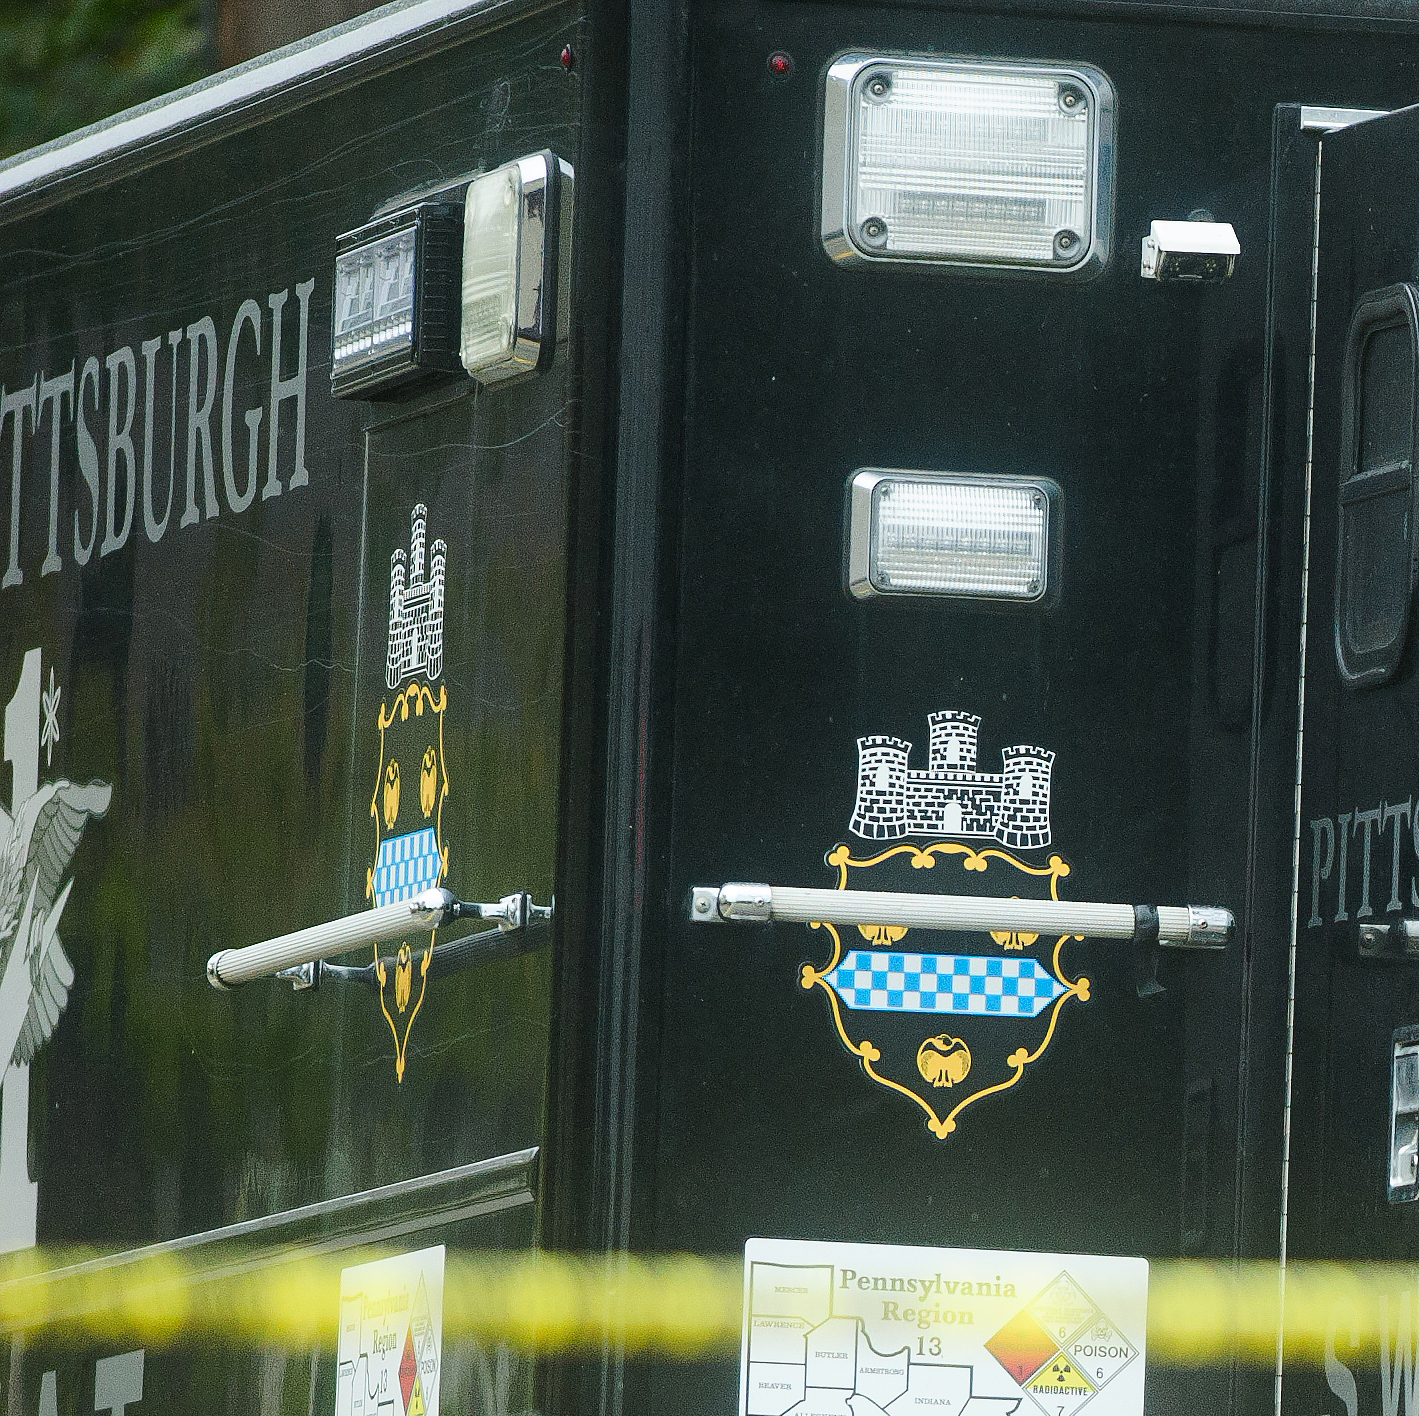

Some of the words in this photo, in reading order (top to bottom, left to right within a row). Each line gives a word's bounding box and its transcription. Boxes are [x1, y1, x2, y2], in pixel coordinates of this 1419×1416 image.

[774, 1286, 809, 1294] MERCER
[838, 1268, 1018, 1303] Pennsylvania
[880, 1300, 975, 1330] Region
[753, 1320, 805, 1329] LAWRENCE
[1058, 1326, 1067, 1339] 6
[373, 1327, 398, 1361] Region
[915, 1335, 942, 1357] 13
[814, 1351, 849, 1360] BUTLER
[1073, 1344, 1129, 1359] POISON
[420, 1358, 437, 1375] POISON
[859, 1367, 905, 1376] ARMSTRONG
[1096, 1367, 1104, 1379] 6
[380, 1368, 388, 1394] 13
[758, 1382, 792, 1390] BEAVER
[1032, 1384, 1088, 1396] RADIOACTIVE
[914, 1397, 952, 1406] INDIANA
[1056, 1405, 1065, 1416] 7
